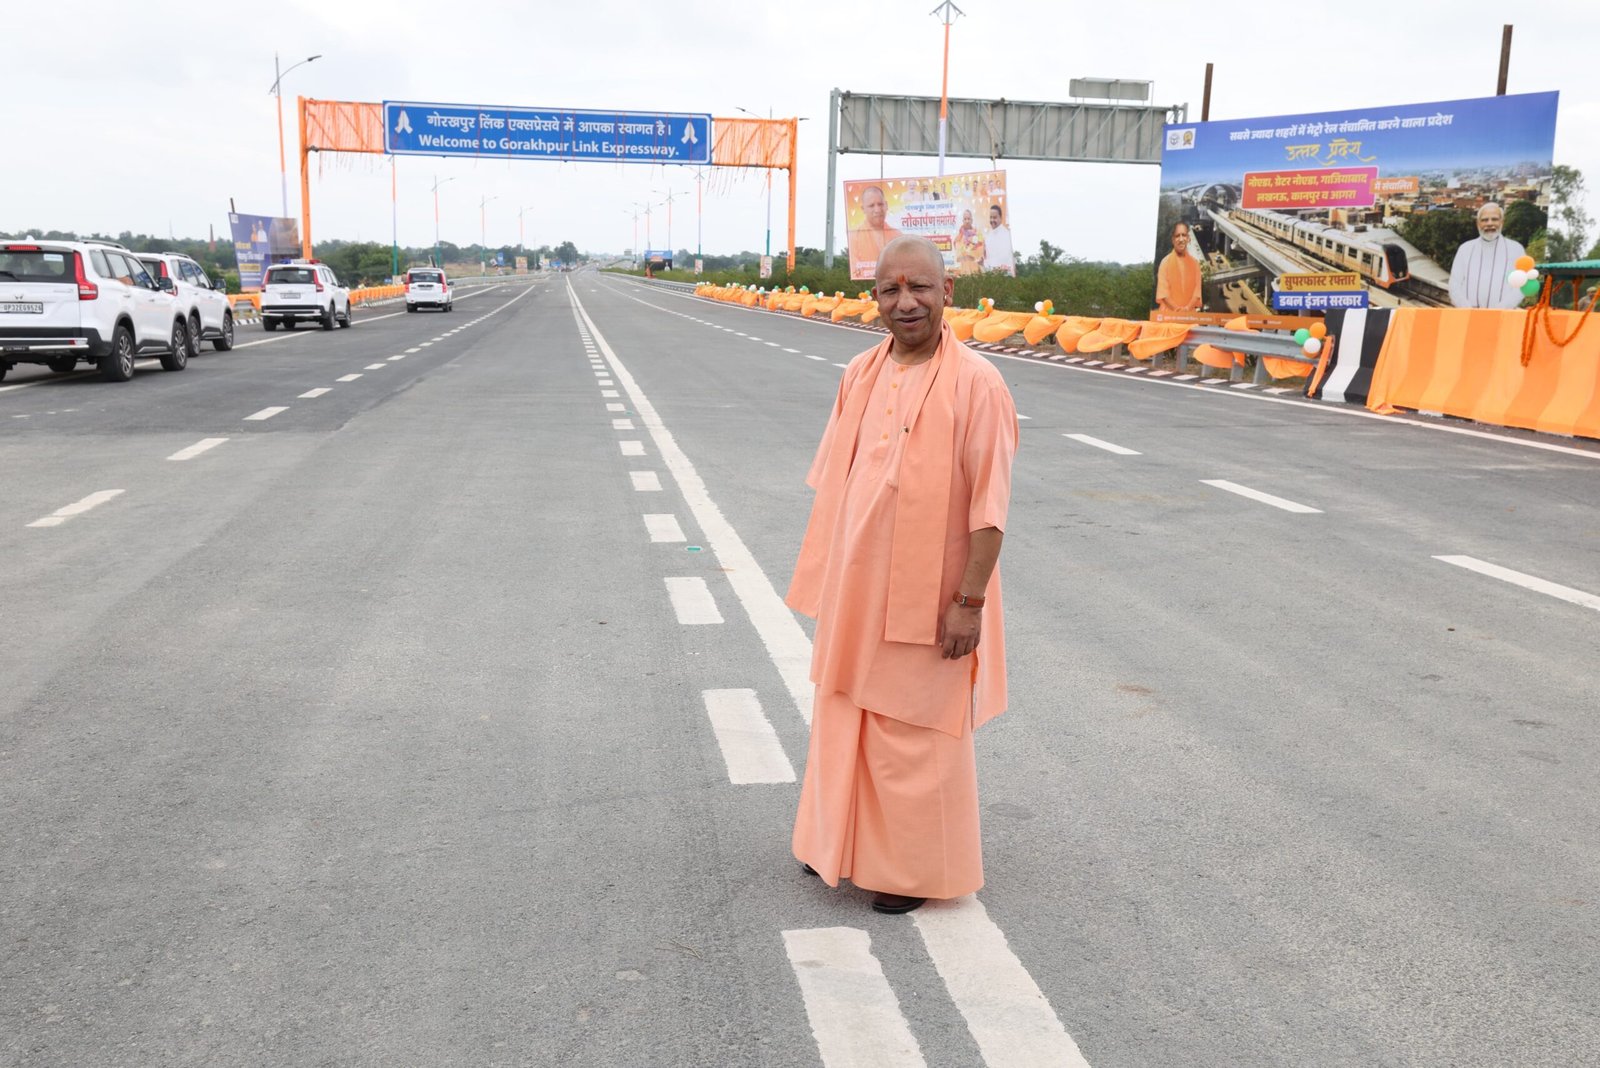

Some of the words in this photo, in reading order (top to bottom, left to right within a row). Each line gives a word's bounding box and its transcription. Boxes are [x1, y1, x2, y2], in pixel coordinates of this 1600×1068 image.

[427, 111, 476, 132] गोरखपुर
[480, 113, 504, 129] लिंक
[507, 115, 560, 132] एक्सप्रेसवे
[563, 116, 574, 132] में
[578, 121, 614, 134] आपका
[618, 122, 653, 135] स्वागत
[1229, 128, 1250, 141] सबसे
[1251, 129, 1274, 140] ज्यादा
[1275, 125, 1297, 138] शहरों
[1298, 125, 1306, 136] में
[1306, 122, 1322, 138] मेट्रो
[1324, 121, 1337, 134] रेल
[1339, 119, 1376, 133] संचालित
[1377, 116, 1400, 130] करने
[1401, 117, 1426, 129] वाला
[1427, 112, 1454, 127] प्रदेश
[418, 134, 479, 148] Welcome
[483, 138, 497, 149] to
[499, 138, 569, 154] Gorakhpur
[573, 141, 599, 153] Link
[602, 142, 679, 158] Expressway.
[1326, 138, 1376, 162] प्रदेश
[1275, 174, 1292, 187] ग्रेटर
[1291, 191, 1320, 204] कानपुर
[1321, 190, 1329, 200] व
[1330, 189, 1357, 200] आगरा
[1284, 275, 1327, 290] सुपरफास्ट
[1328, 275, 1356, 286] रफ्तार
[1279, 294, 1302, 307] डबल
[1304, 292, 1328, 309] इंजन
[1329, 294, 1362, 307] सरकार
